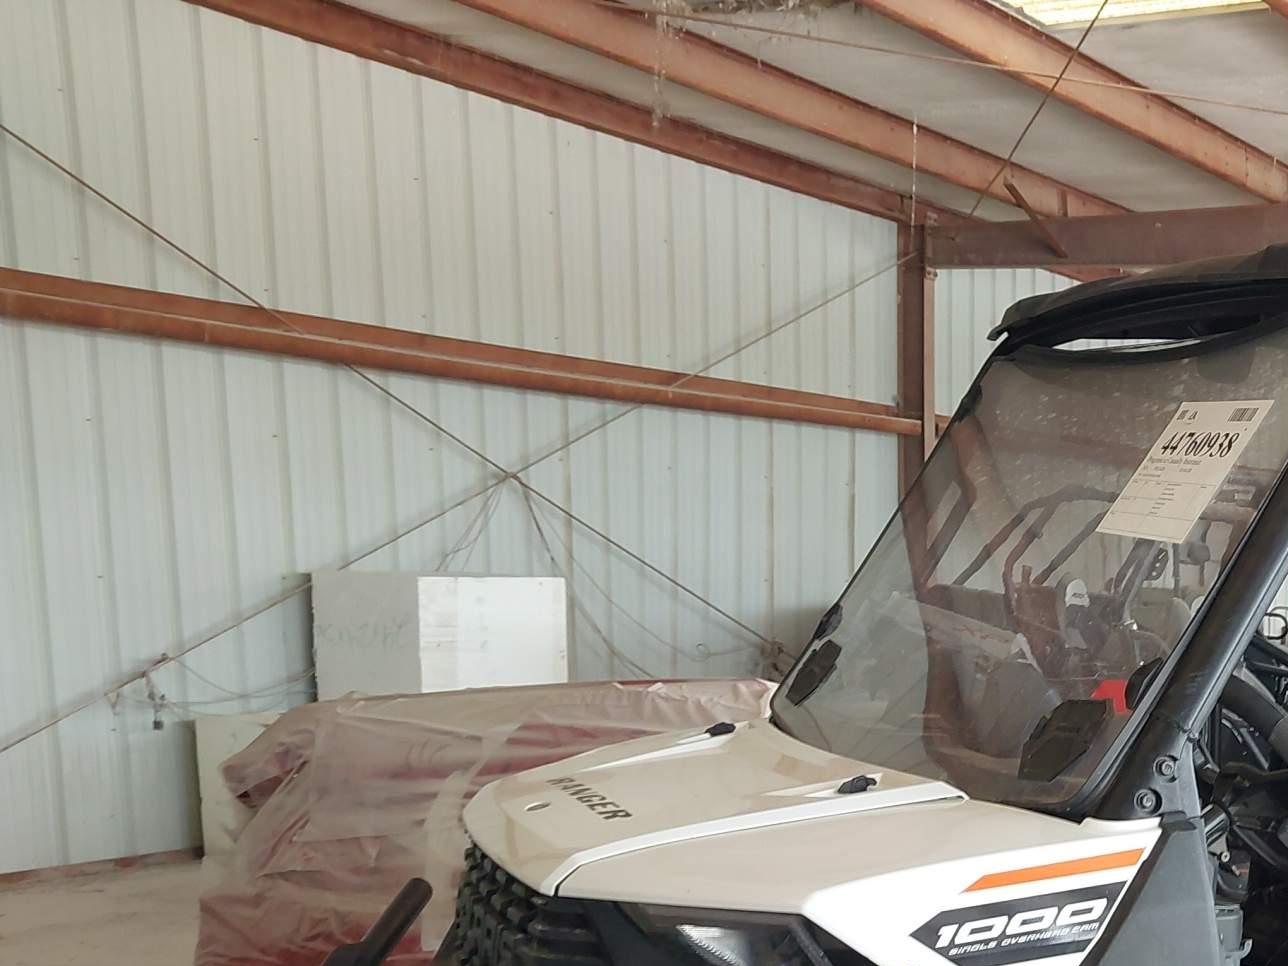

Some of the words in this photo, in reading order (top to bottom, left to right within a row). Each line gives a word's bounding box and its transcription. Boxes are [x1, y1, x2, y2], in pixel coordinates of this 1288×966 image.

[1160, 431, 1240, 458] 44760938
[546, 777, 633, 820] RANGER
[935, 897, 1108, 949] 1000
[948, 940, 998, 956] SINGLE
[1000, 926, 1071, 947] OVERHEAD
[1071, 921, 1100, 934] CAM
